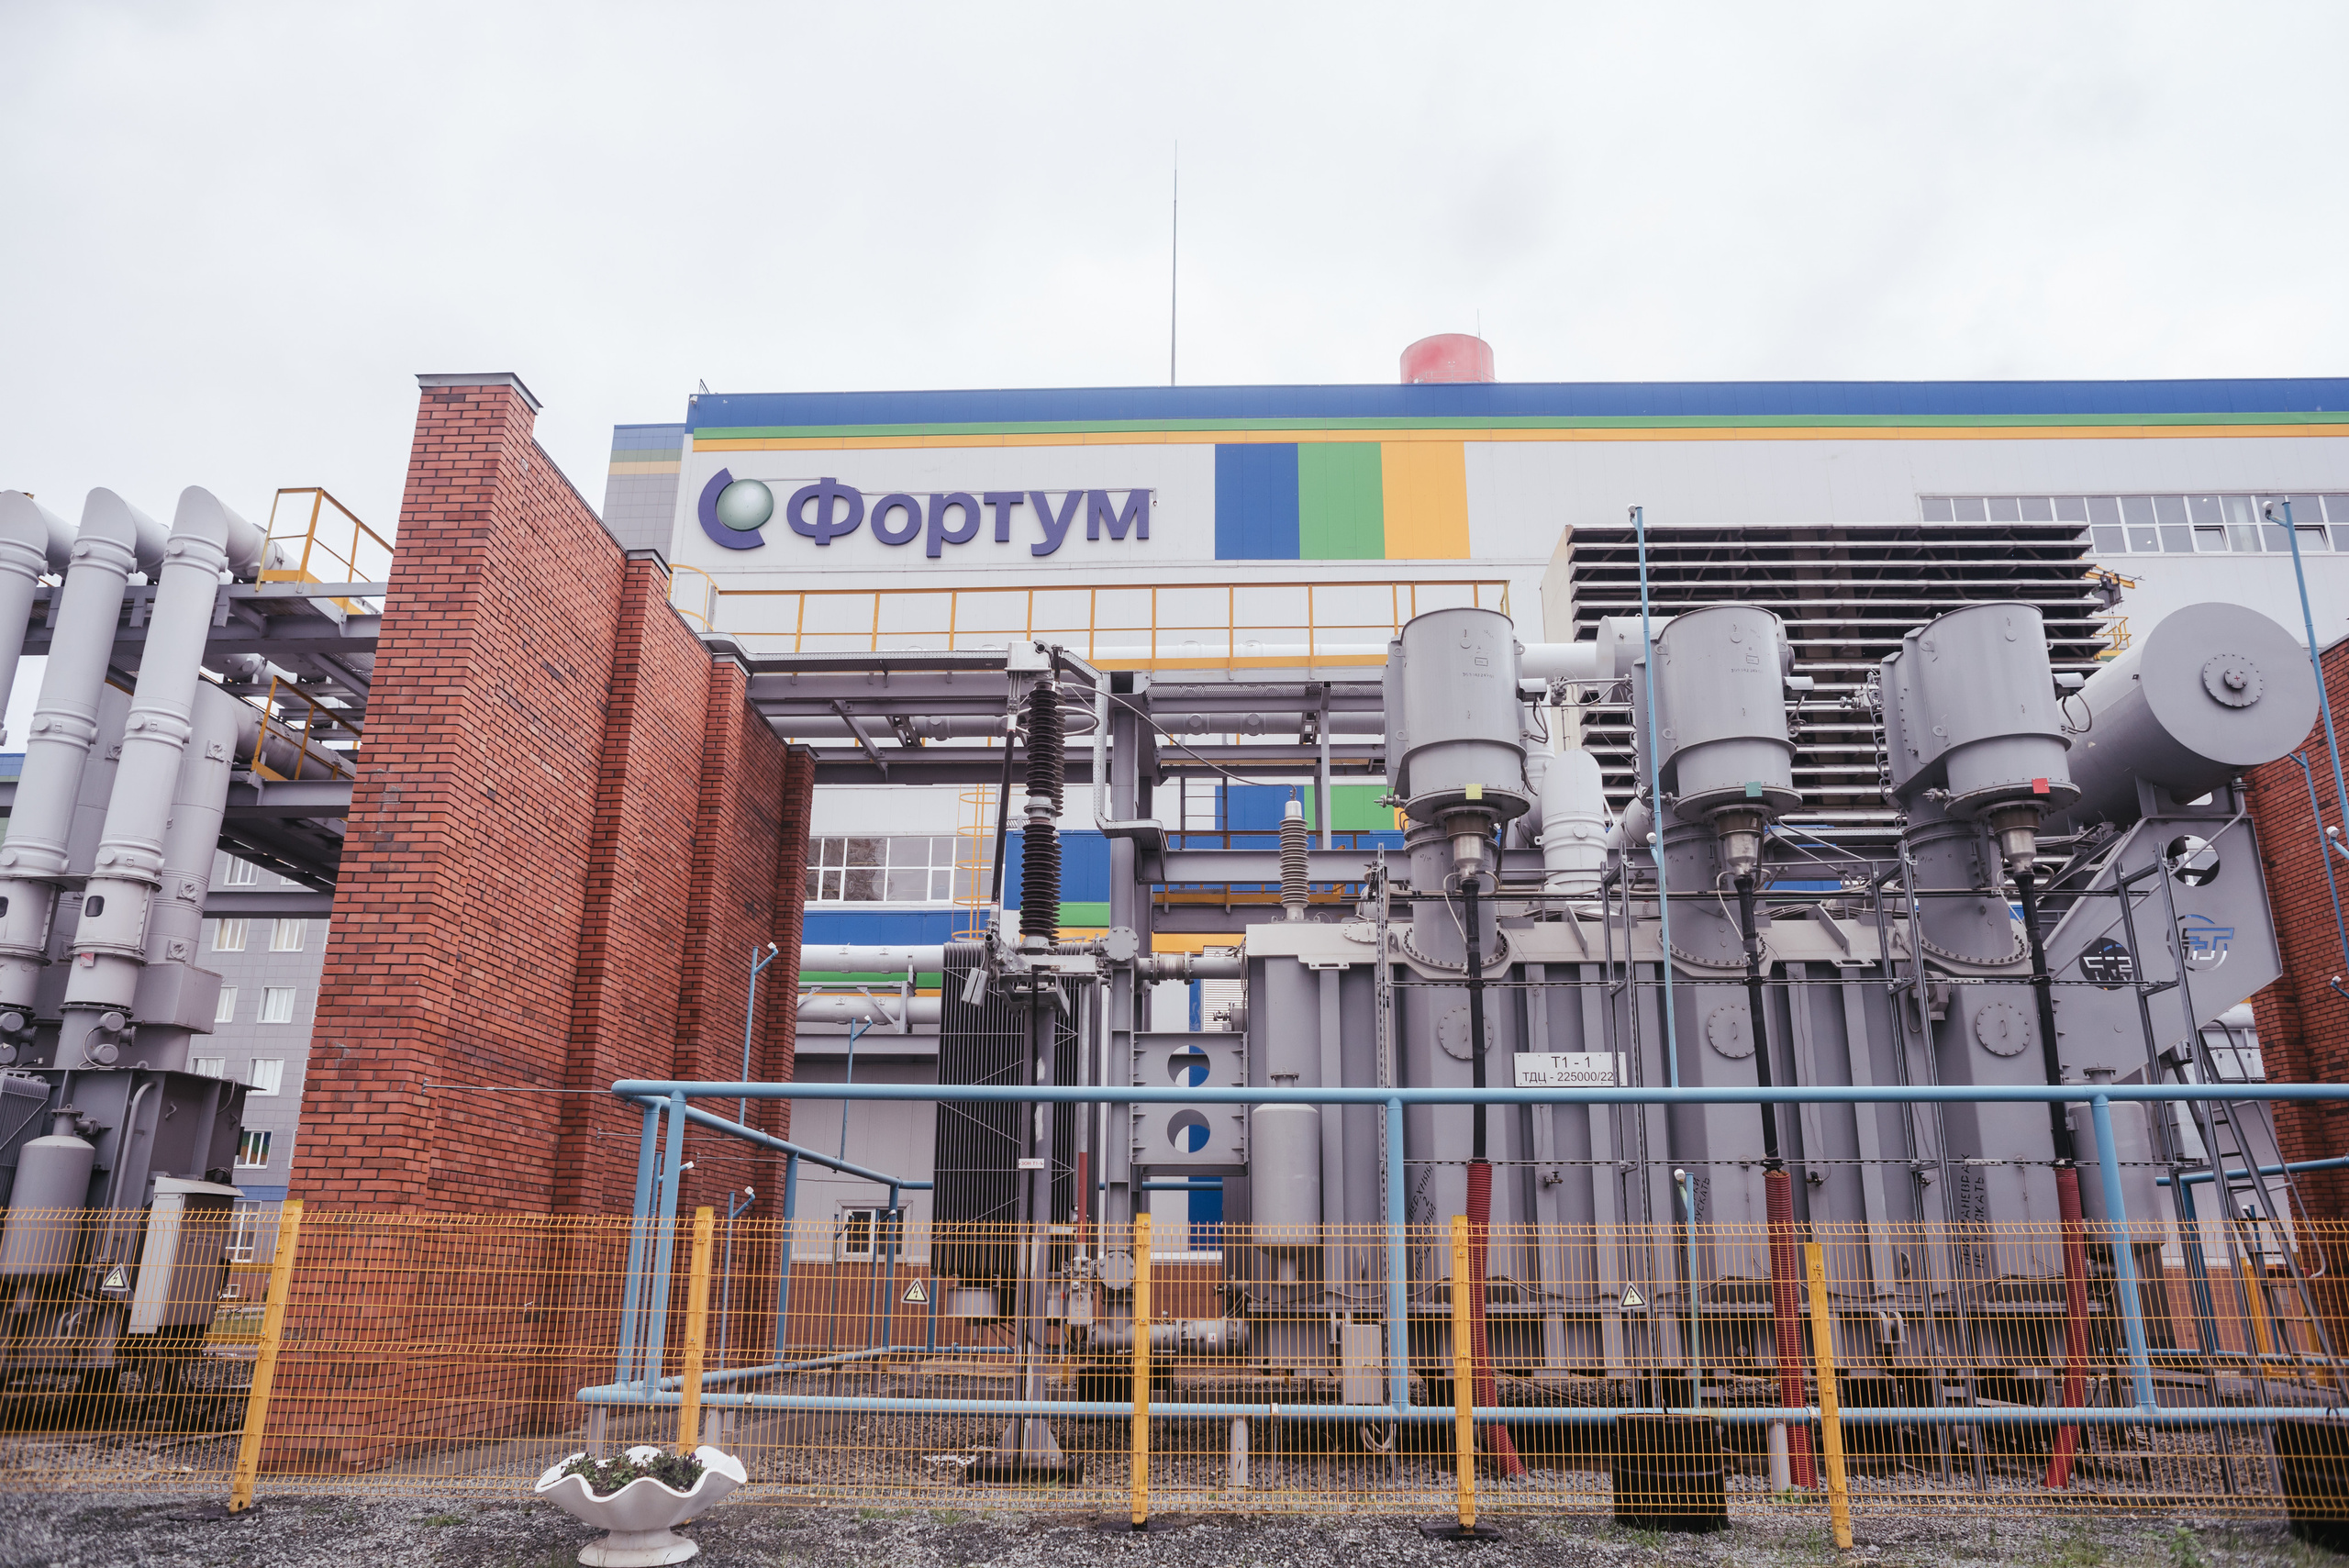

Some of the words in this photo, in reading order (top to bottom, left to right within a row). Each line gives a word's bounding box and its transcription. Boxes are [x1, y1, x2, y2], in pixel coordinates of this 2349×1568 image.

[786, 477, 1150, 558] Фортум
[1522, 1072, 1546, 1084] ТДЦ
[1557, 1072, 1614, 1082] 225000/22
